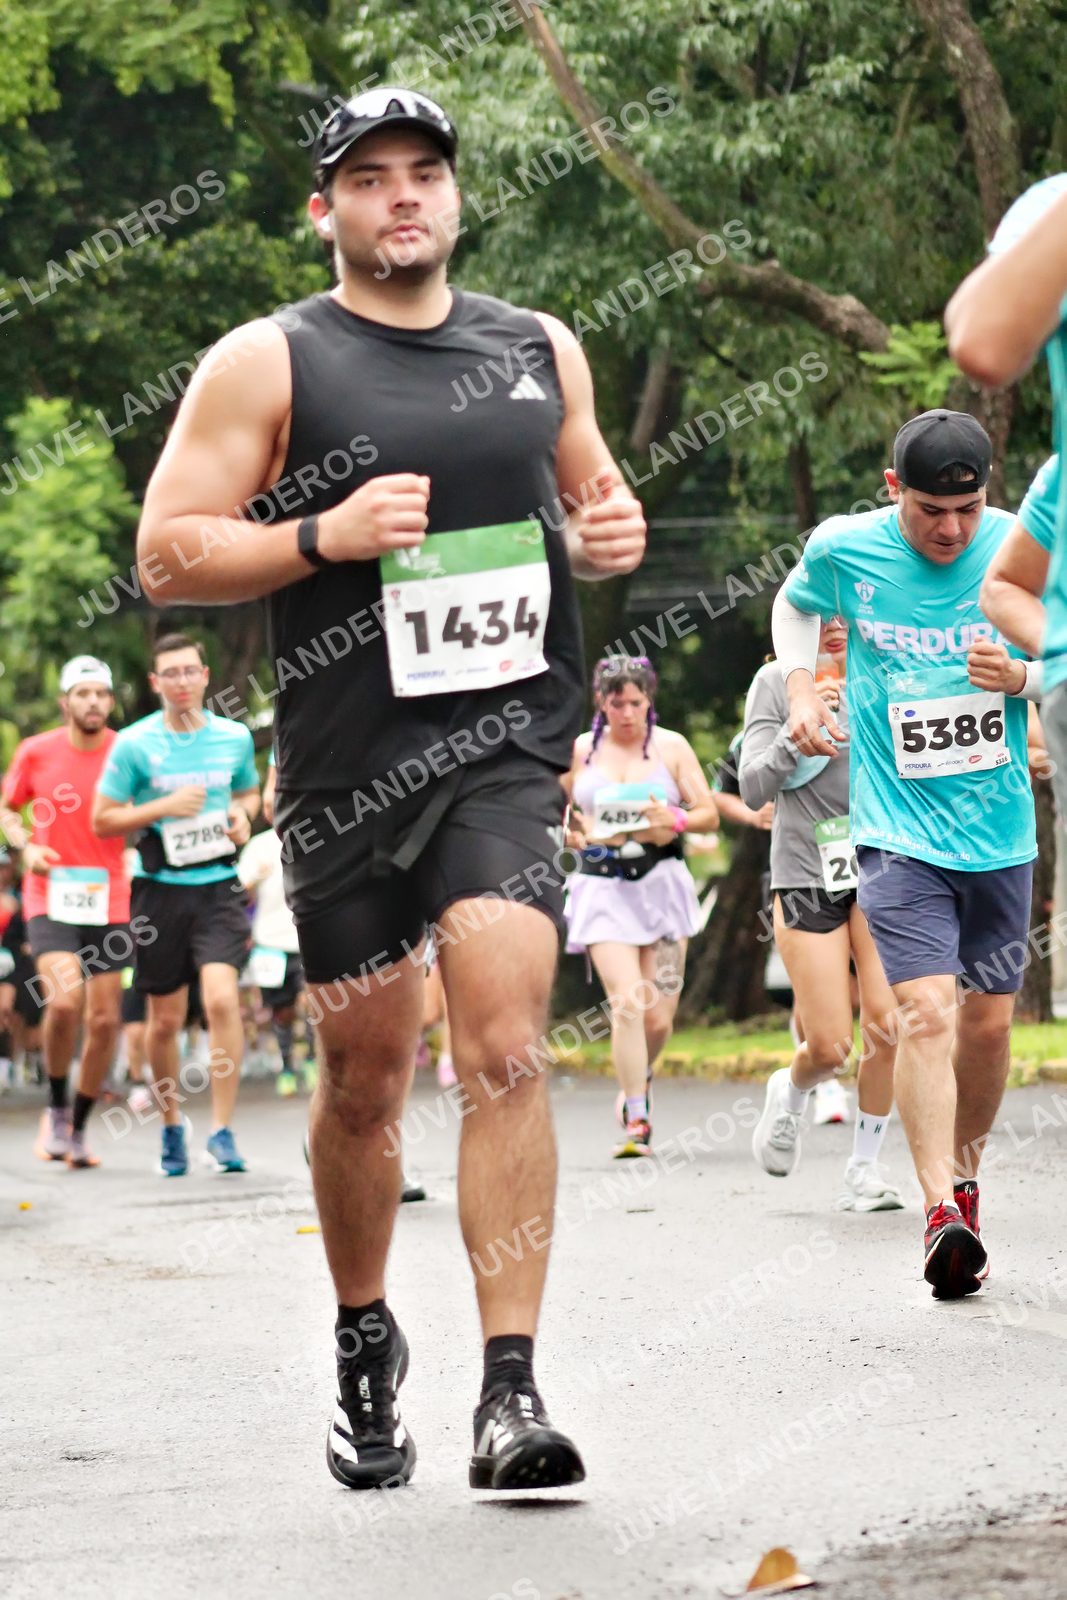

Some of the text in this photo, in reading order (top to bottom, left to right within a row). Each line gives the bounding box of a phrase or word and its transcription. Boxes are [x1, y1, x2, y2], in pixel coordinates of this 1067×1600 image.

[405, 596, 539, 655] 1434
[901, 710, 1004, 754] 5386
[173, 824, 225, 850] 2789
